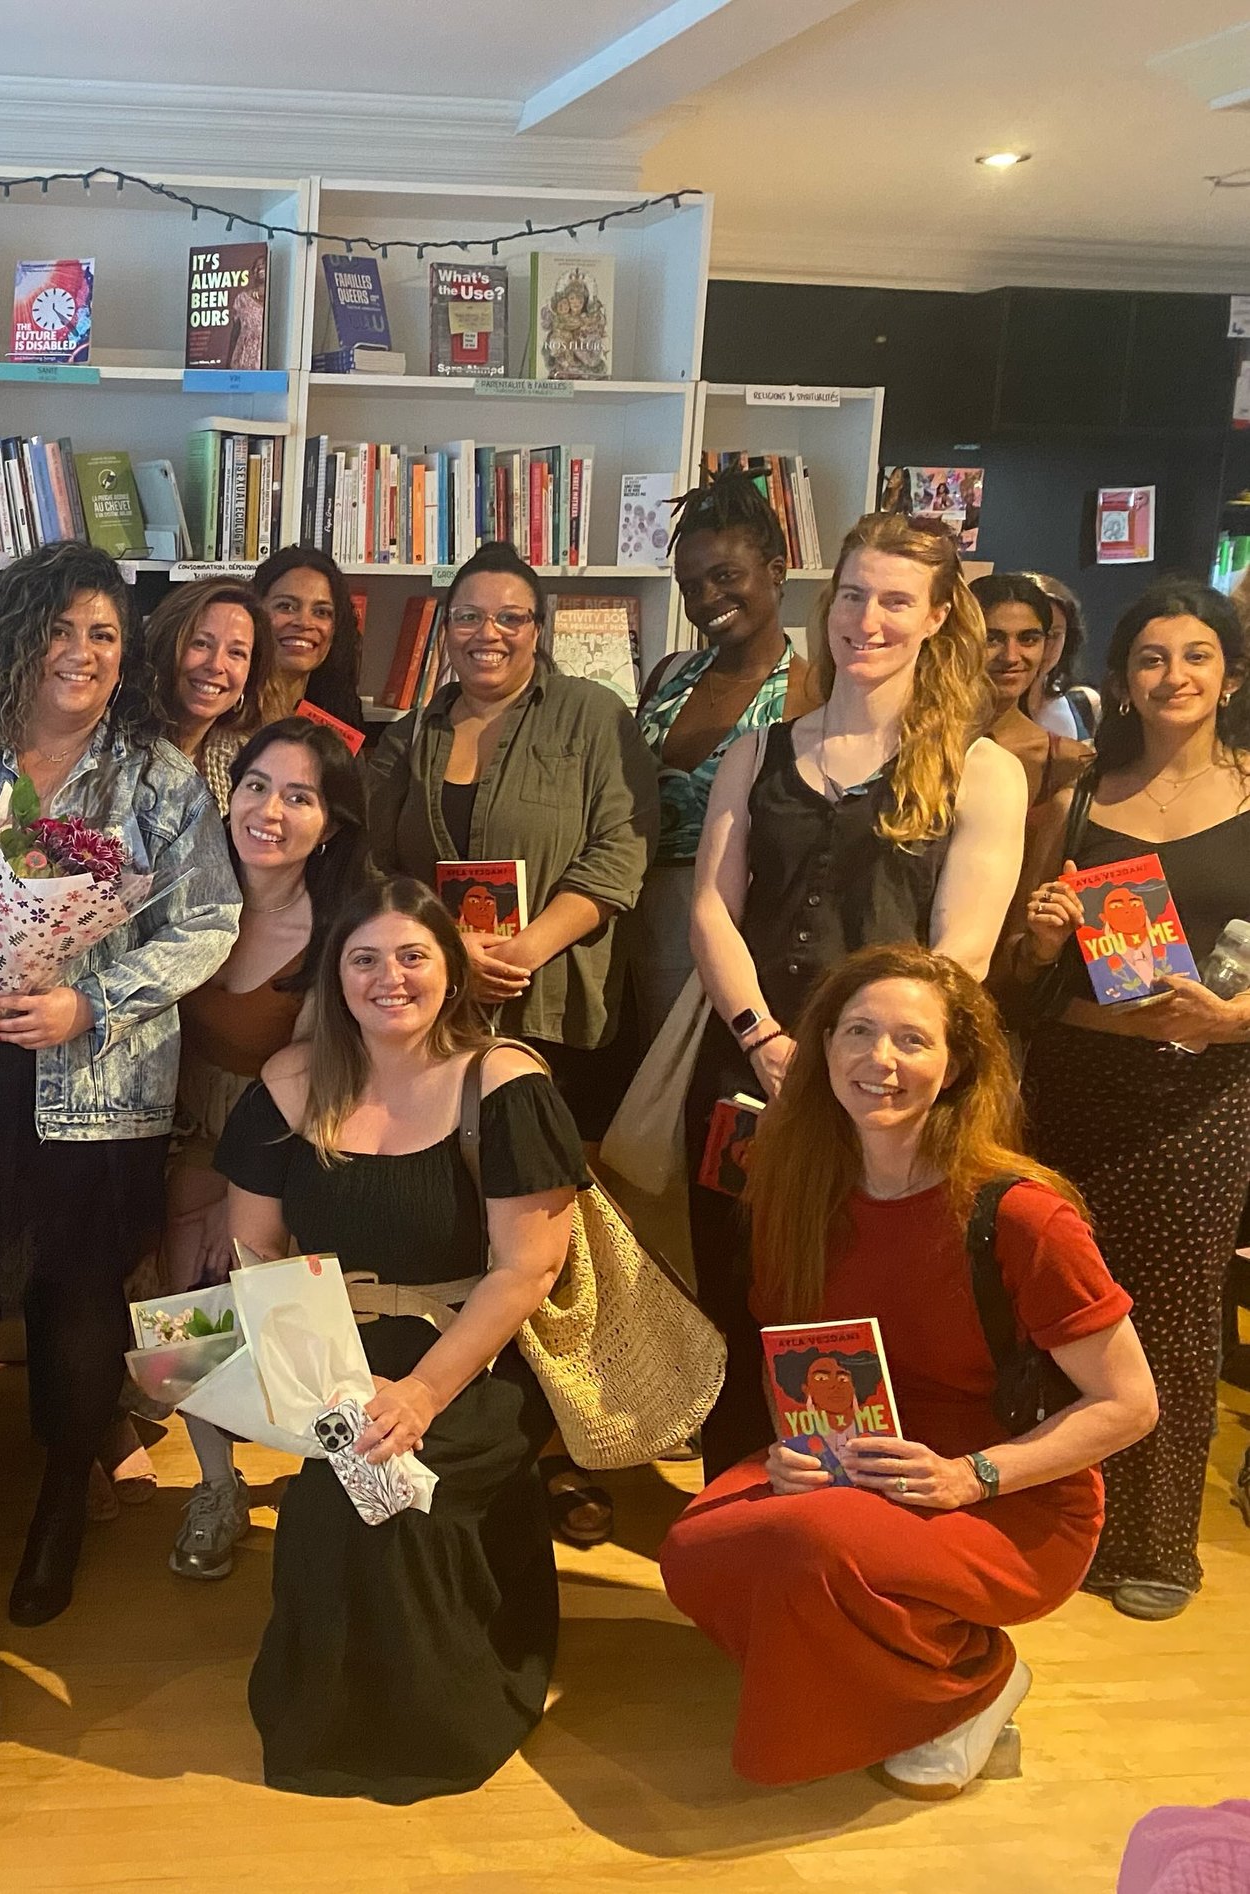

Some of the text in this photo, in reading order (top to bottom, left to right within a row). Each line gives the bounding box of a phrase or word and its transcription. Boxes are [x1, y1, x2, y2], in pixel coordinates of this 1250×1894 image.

[192, 253, 220, 271] IT'S
[191, 270, 249, 290] ALWAYS
[334, 272, 372, 290] FAMILLES
[438, 269, 490, 284] What's
[191, 290, 228, 309] BEEN
[337, 288, 370, 305] QUEERS
[438, 285, 505, 301] the Use?
[190, 309, 230, 328] OURS
[16, 323, 32, 331] THE
[15, 330, 57, 341] FUTURE
[14, 340, 77, 351] IS DISABLED
[544, 341, 567, 350] NOS
[753, 391, 786, 400] RELIGIONS
[236, 466, 246, 503] SEXUAL
[94, 500, 131, 512] AU CHEVET
[234, 506, 245, 544] ECOLOGY
[585, 598, 609, 609] BIG
[1076, 875, 1102, 886] AYLA
[1084, 932, 1129, 961] YOU
[1149, 920, 1180, 947] ME
[778, 1338, 805, 1348] AYLA
[784, 1409, 832, 1437] YOU
[854, 1403, 889, 1433] ME
